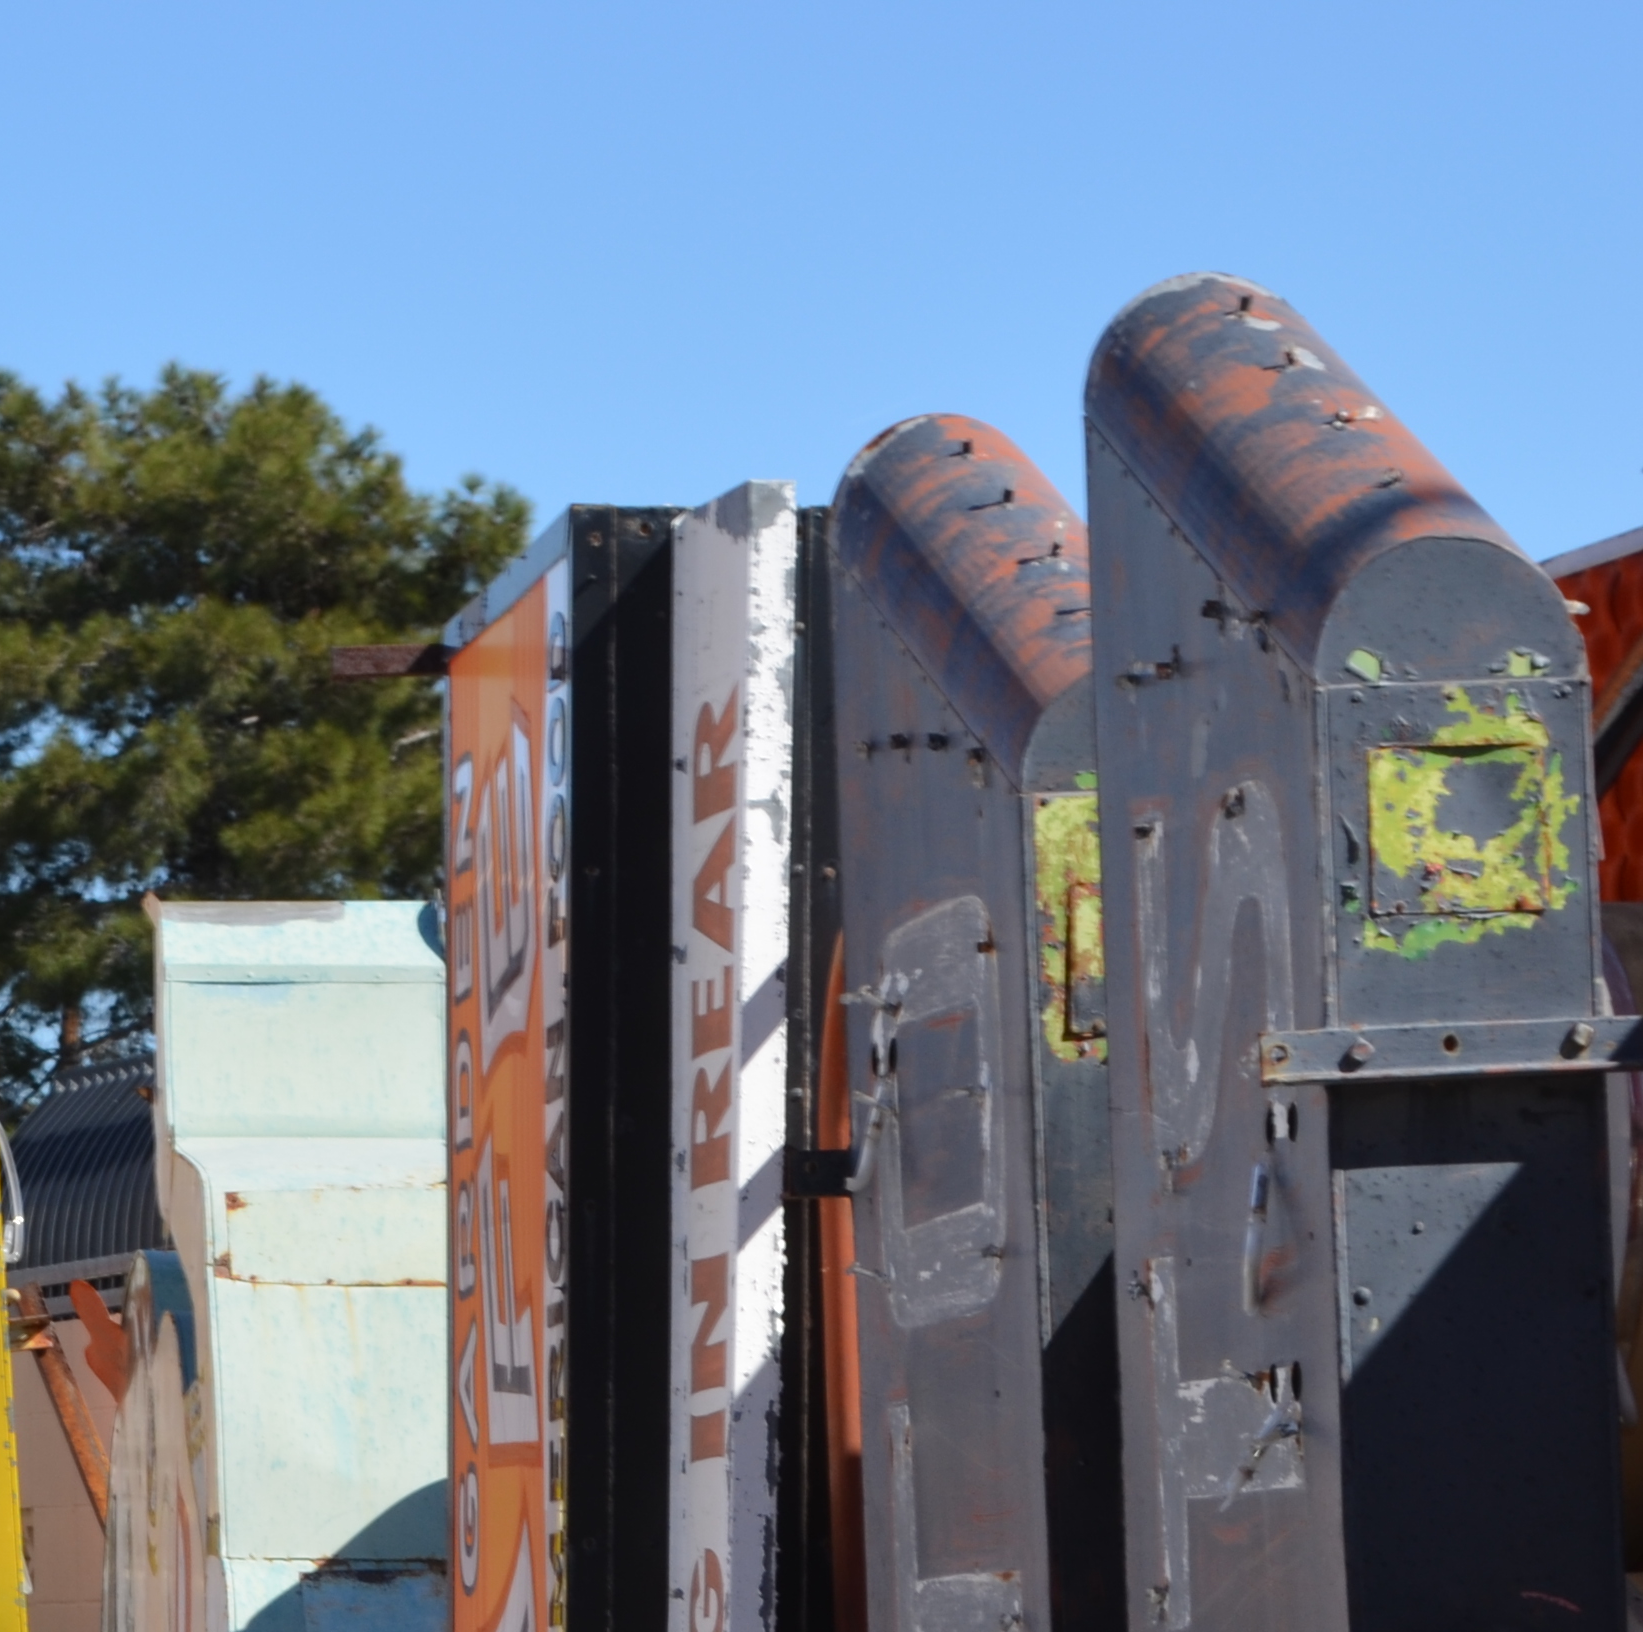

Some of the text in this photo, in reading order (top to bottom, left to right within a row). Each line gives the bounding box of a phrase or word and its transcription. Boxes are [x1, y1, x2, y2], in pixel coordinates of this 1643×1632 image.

[545, 610, 568, 948] FOOD
[690, 682, 741, 1192] REAR
[450, 750, 480, 1597] GARDEN
[689, 1252, 729, 1464] IN
